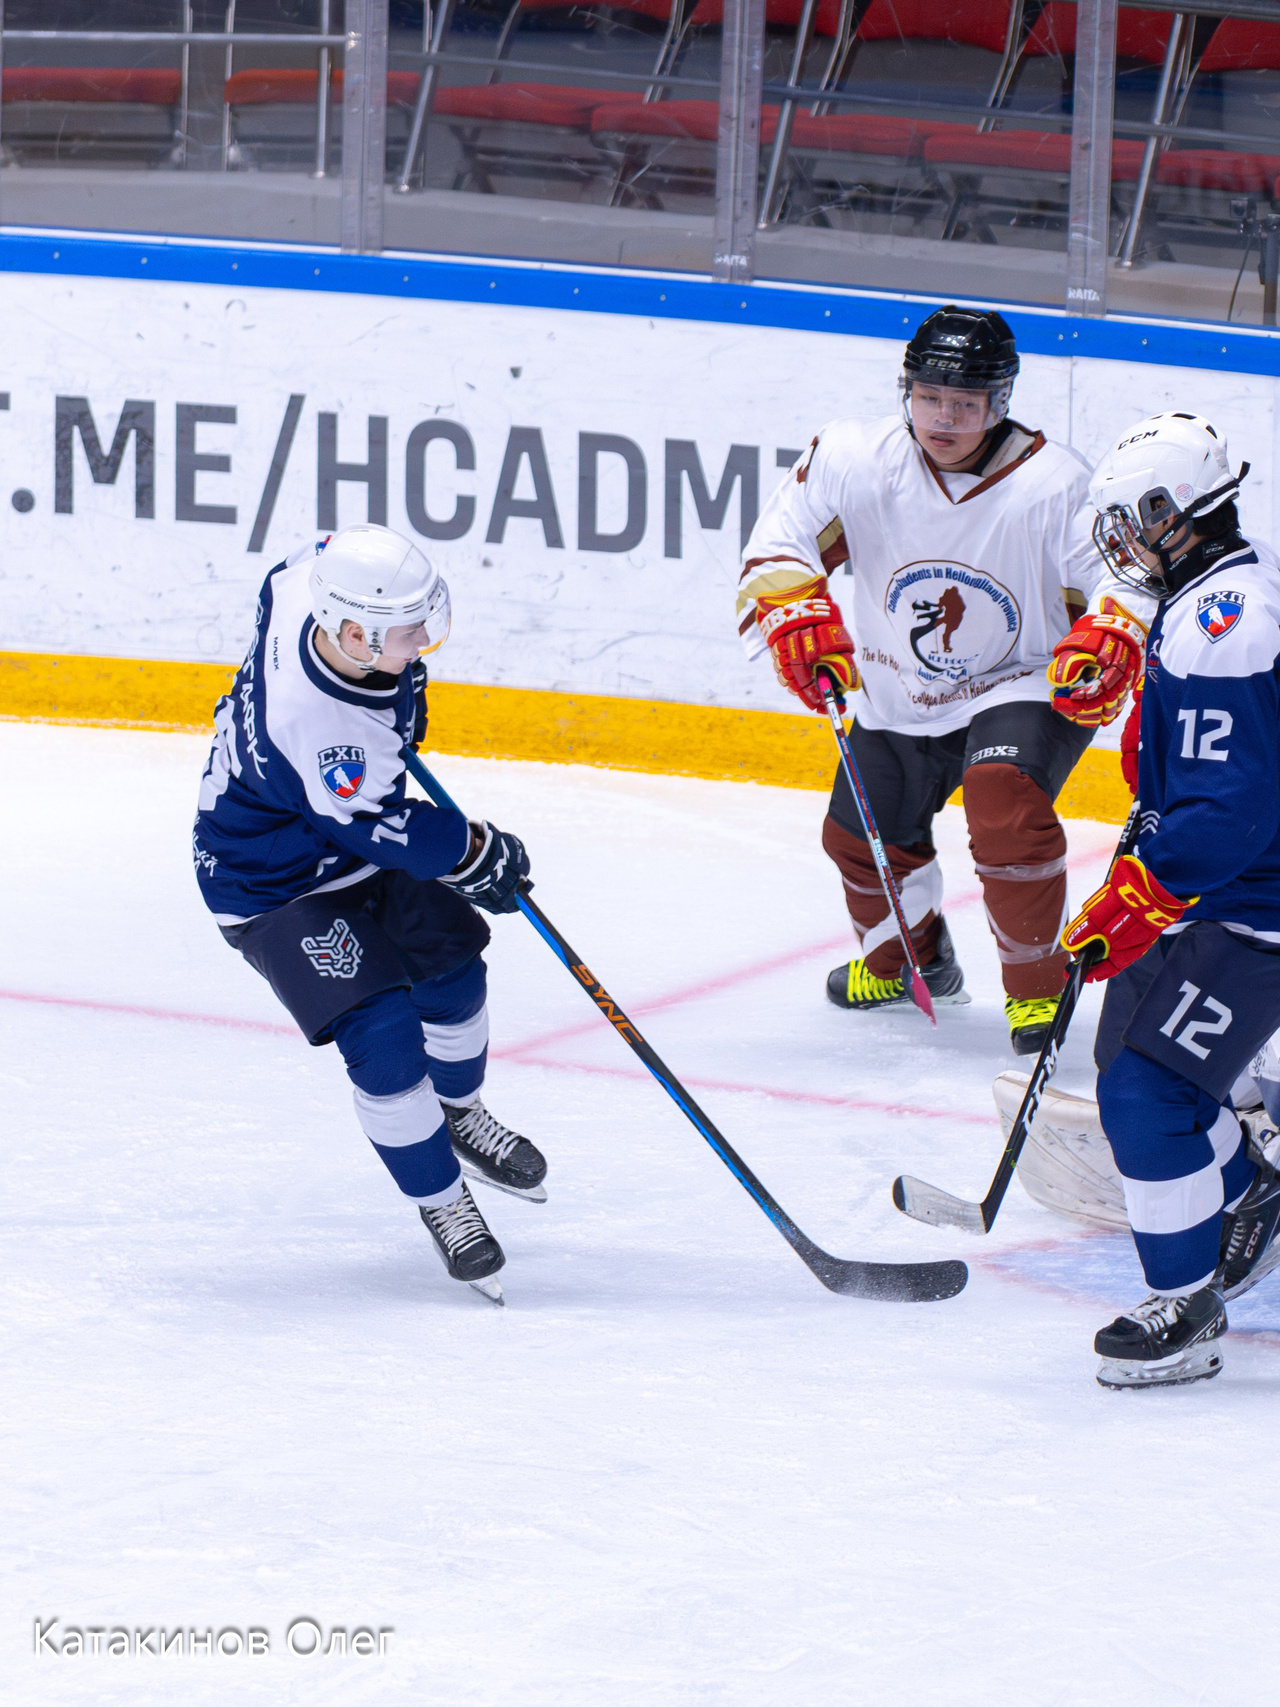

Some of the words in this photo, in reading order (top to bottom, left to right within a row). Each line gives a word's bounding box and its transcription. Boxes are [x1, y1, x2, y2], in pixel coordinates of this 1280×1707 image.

[925, 359, 962, 370] CCM
[1117, 429, 1159, 451] CCM
[329, 592, 366, 610] BAUER
[1177, 708, 1233, 762] 12
[1119, 810, 1137, 843] CCM
[1117, 881, 1177, 927] CC
[1067, 920, 1088, 944] CCM
[570, 964, 643, 1044] SYNC
[1160, 980, 1234, 1060] 12
